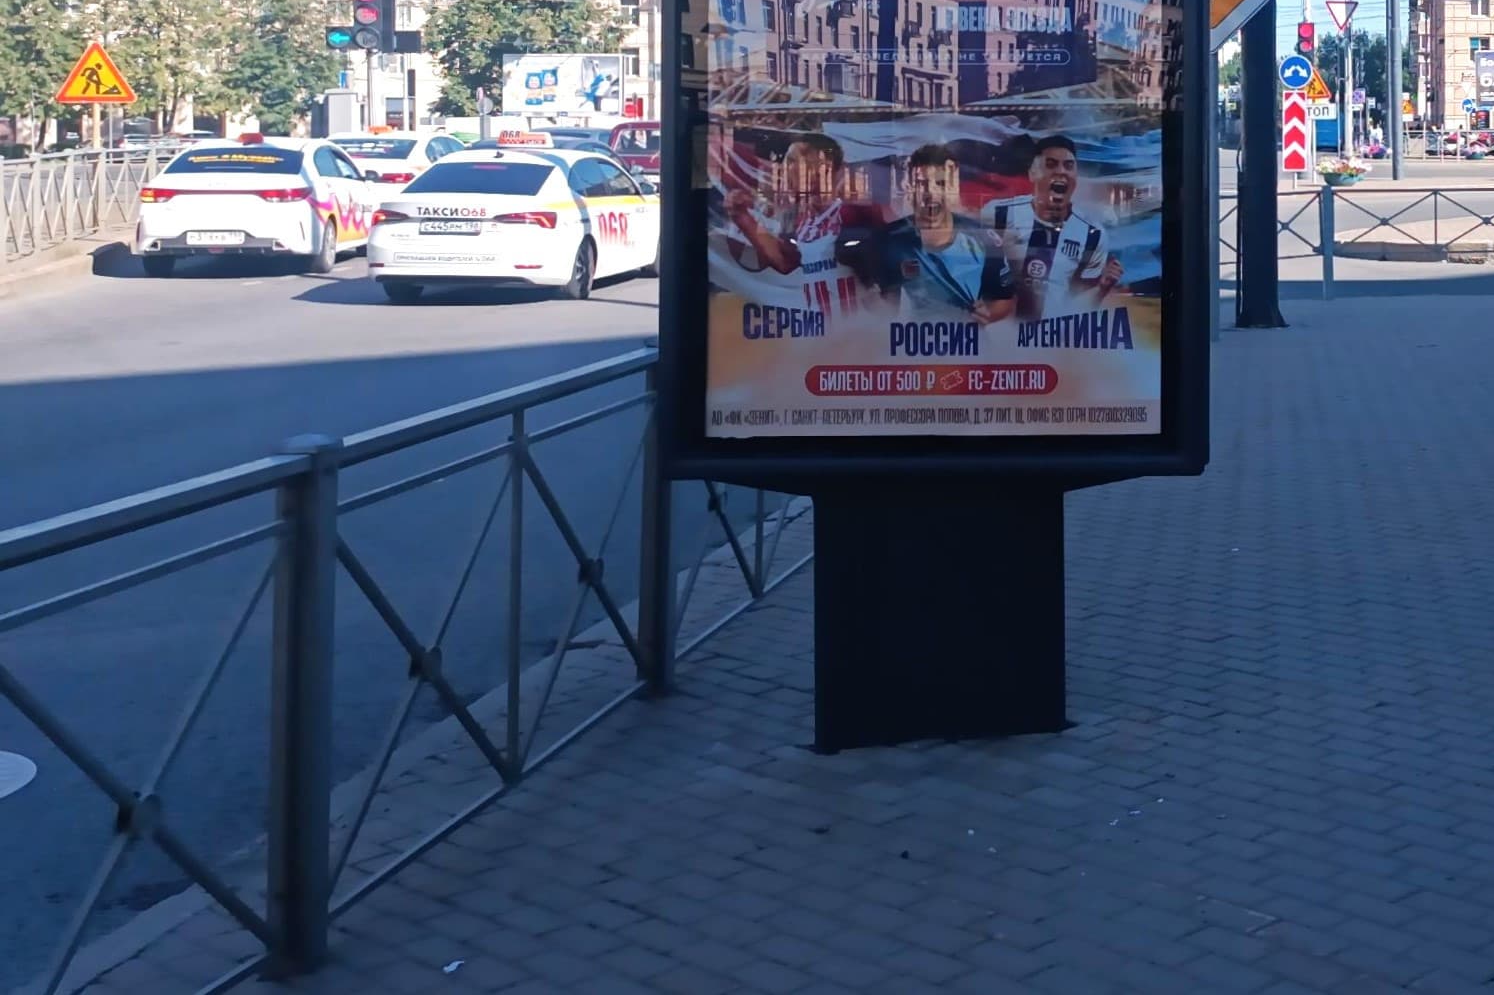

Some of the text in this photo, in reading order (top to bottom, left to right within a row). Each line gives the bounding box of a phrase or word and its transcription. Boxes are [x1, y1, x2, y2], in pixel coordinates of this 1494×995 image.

[1306, 105, 1330, 117] ТОП
[742, 302, 826, 340] СЕРБИЯ
[1017, 306, 1134, 351] АРГЕНТИНА
[889, 321, 980, 357] РОССИЯ
[819, 370, 874, 393] БИЛЕТЫ
[877, 370, 893, 392] ОТ
[896, 370, 921, 392] 500
[967, 369, 1047, 391] FC-ZENIT.RU
[711, 409, 723, 427] АО
[883, 407, 936, 424] ПРОФЕССОРА
[1026, 407, 1050, 423] ОФИС
[1066, 406, 1086, 423] ОГРН
